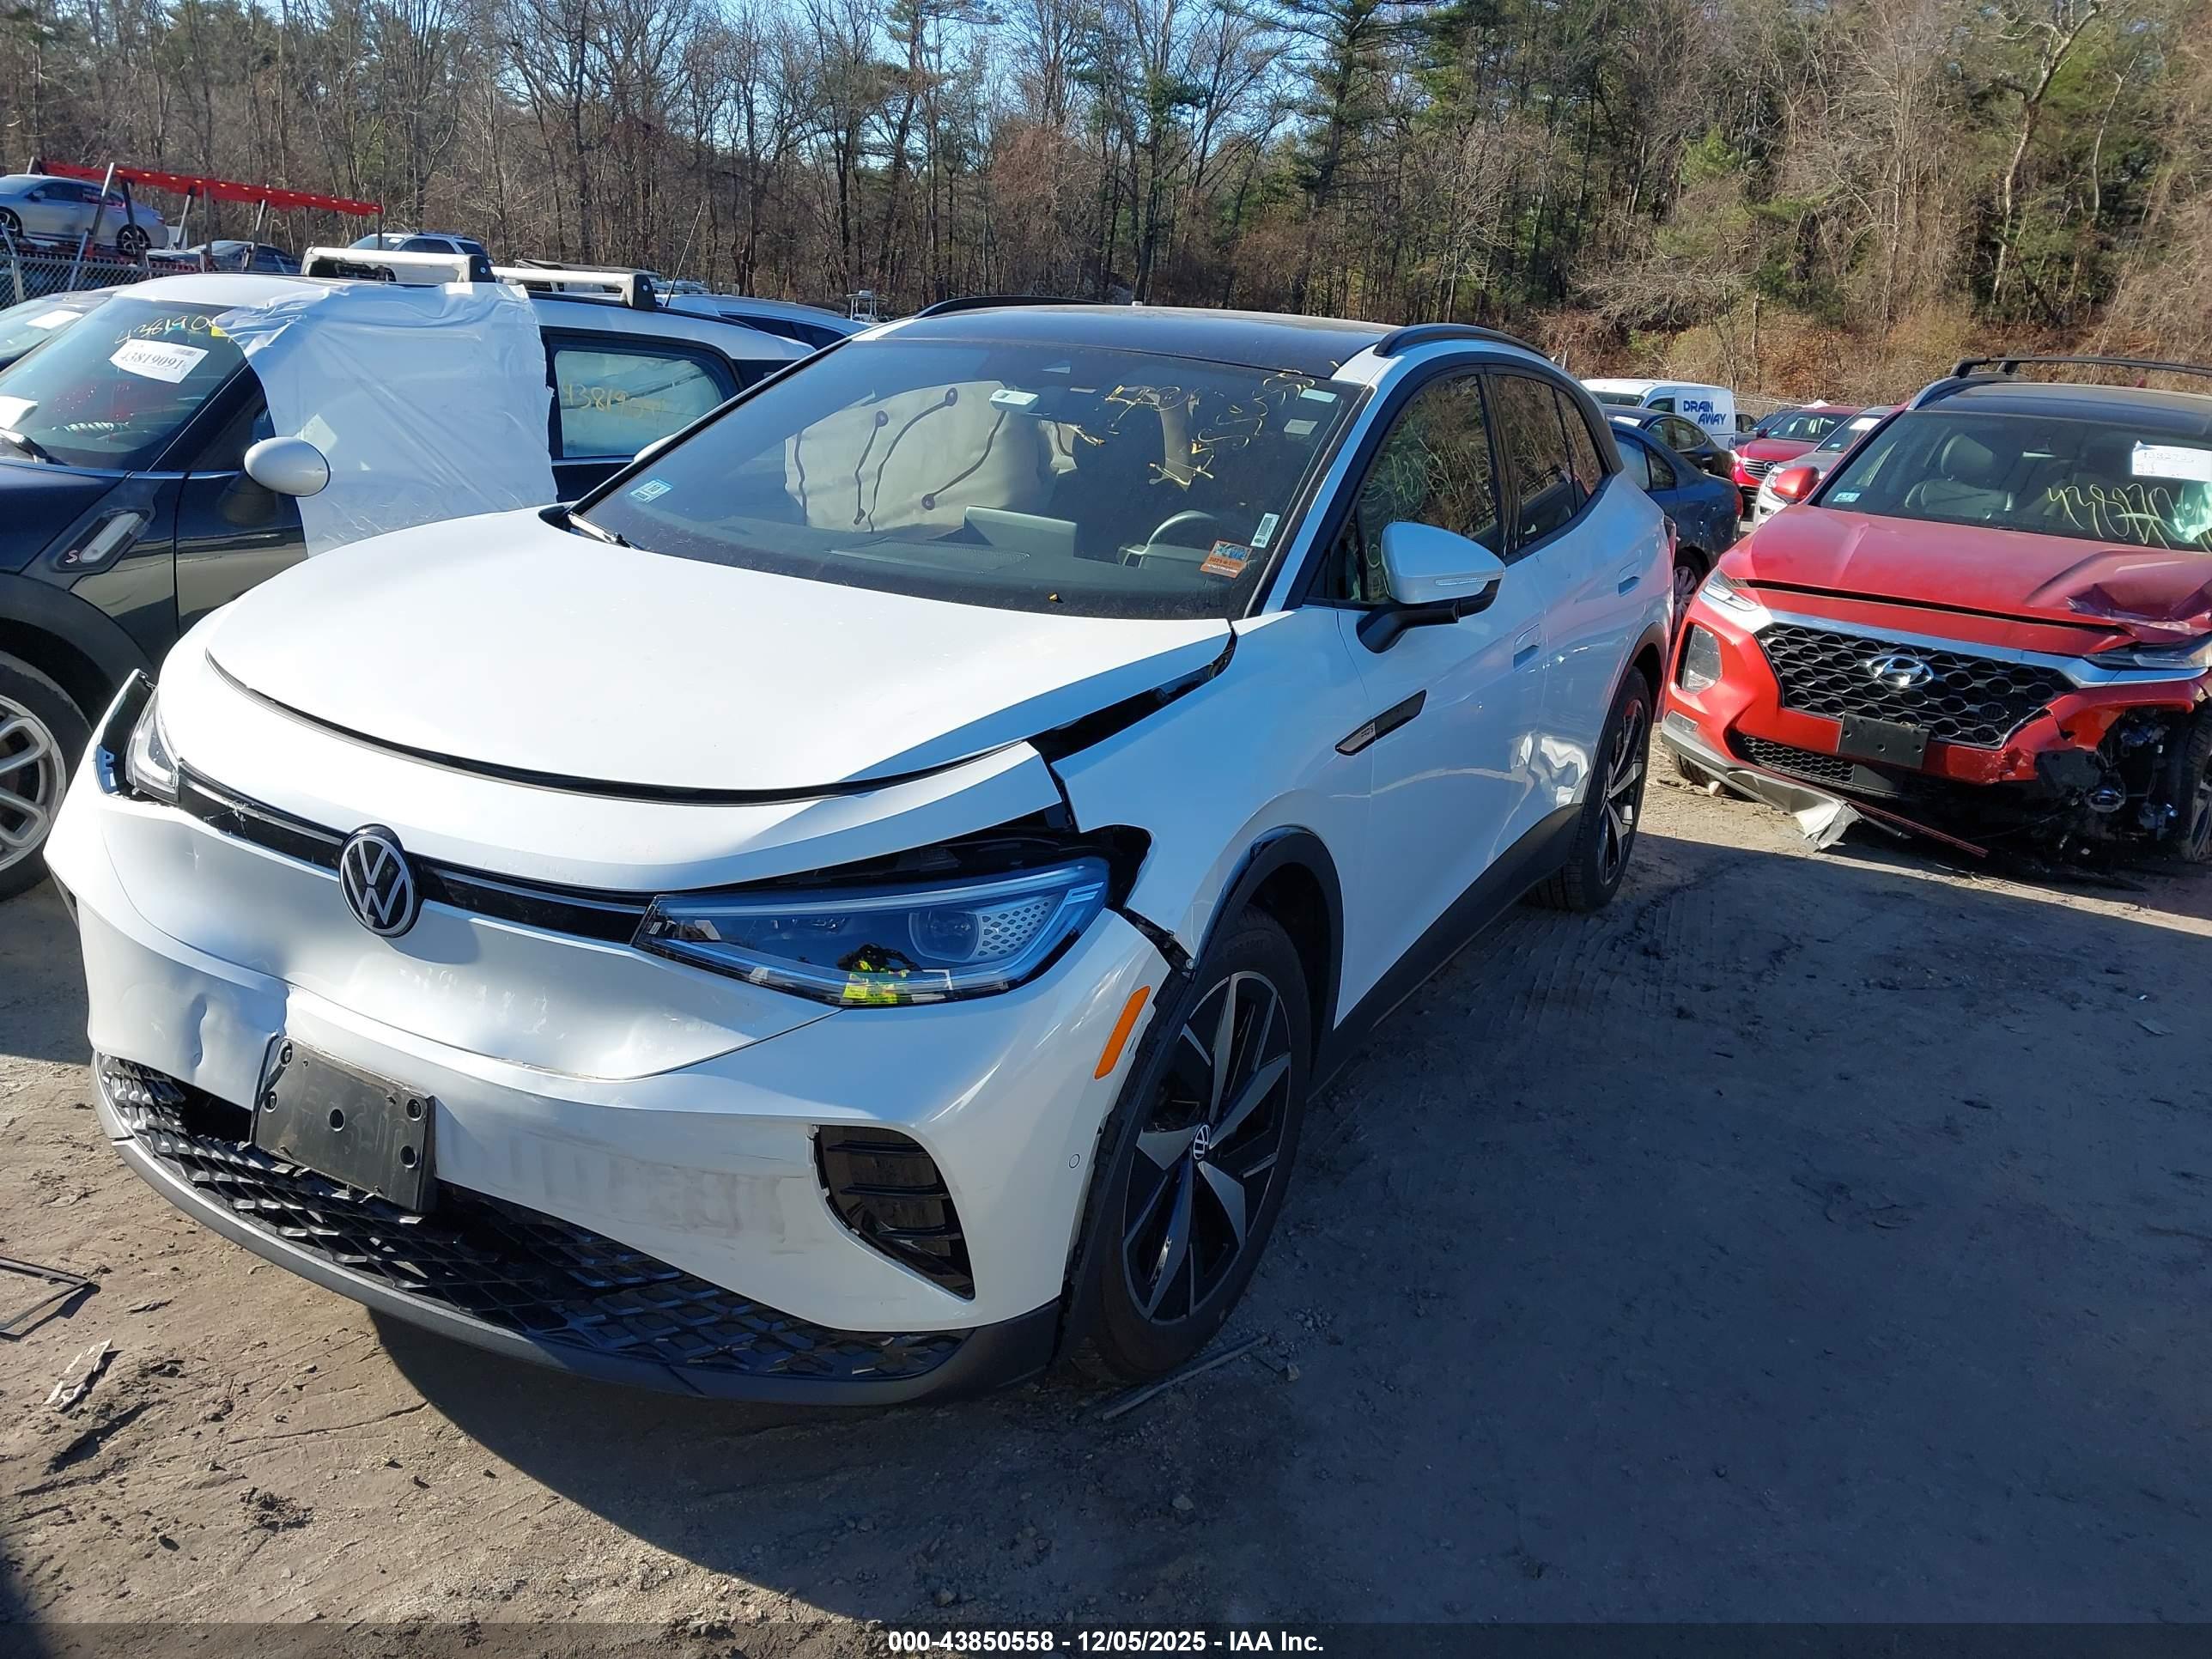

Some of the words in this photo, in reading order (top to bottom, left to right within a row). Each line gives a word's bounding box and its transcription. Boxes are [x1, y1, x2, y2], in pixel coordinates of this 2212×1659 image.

[1683, 400, 1713, 412] DRAIN
[1698, 413, 1727, 425] AWAY
[64, 549, 79, 563] S
[340, 836, 414, 936] VW
